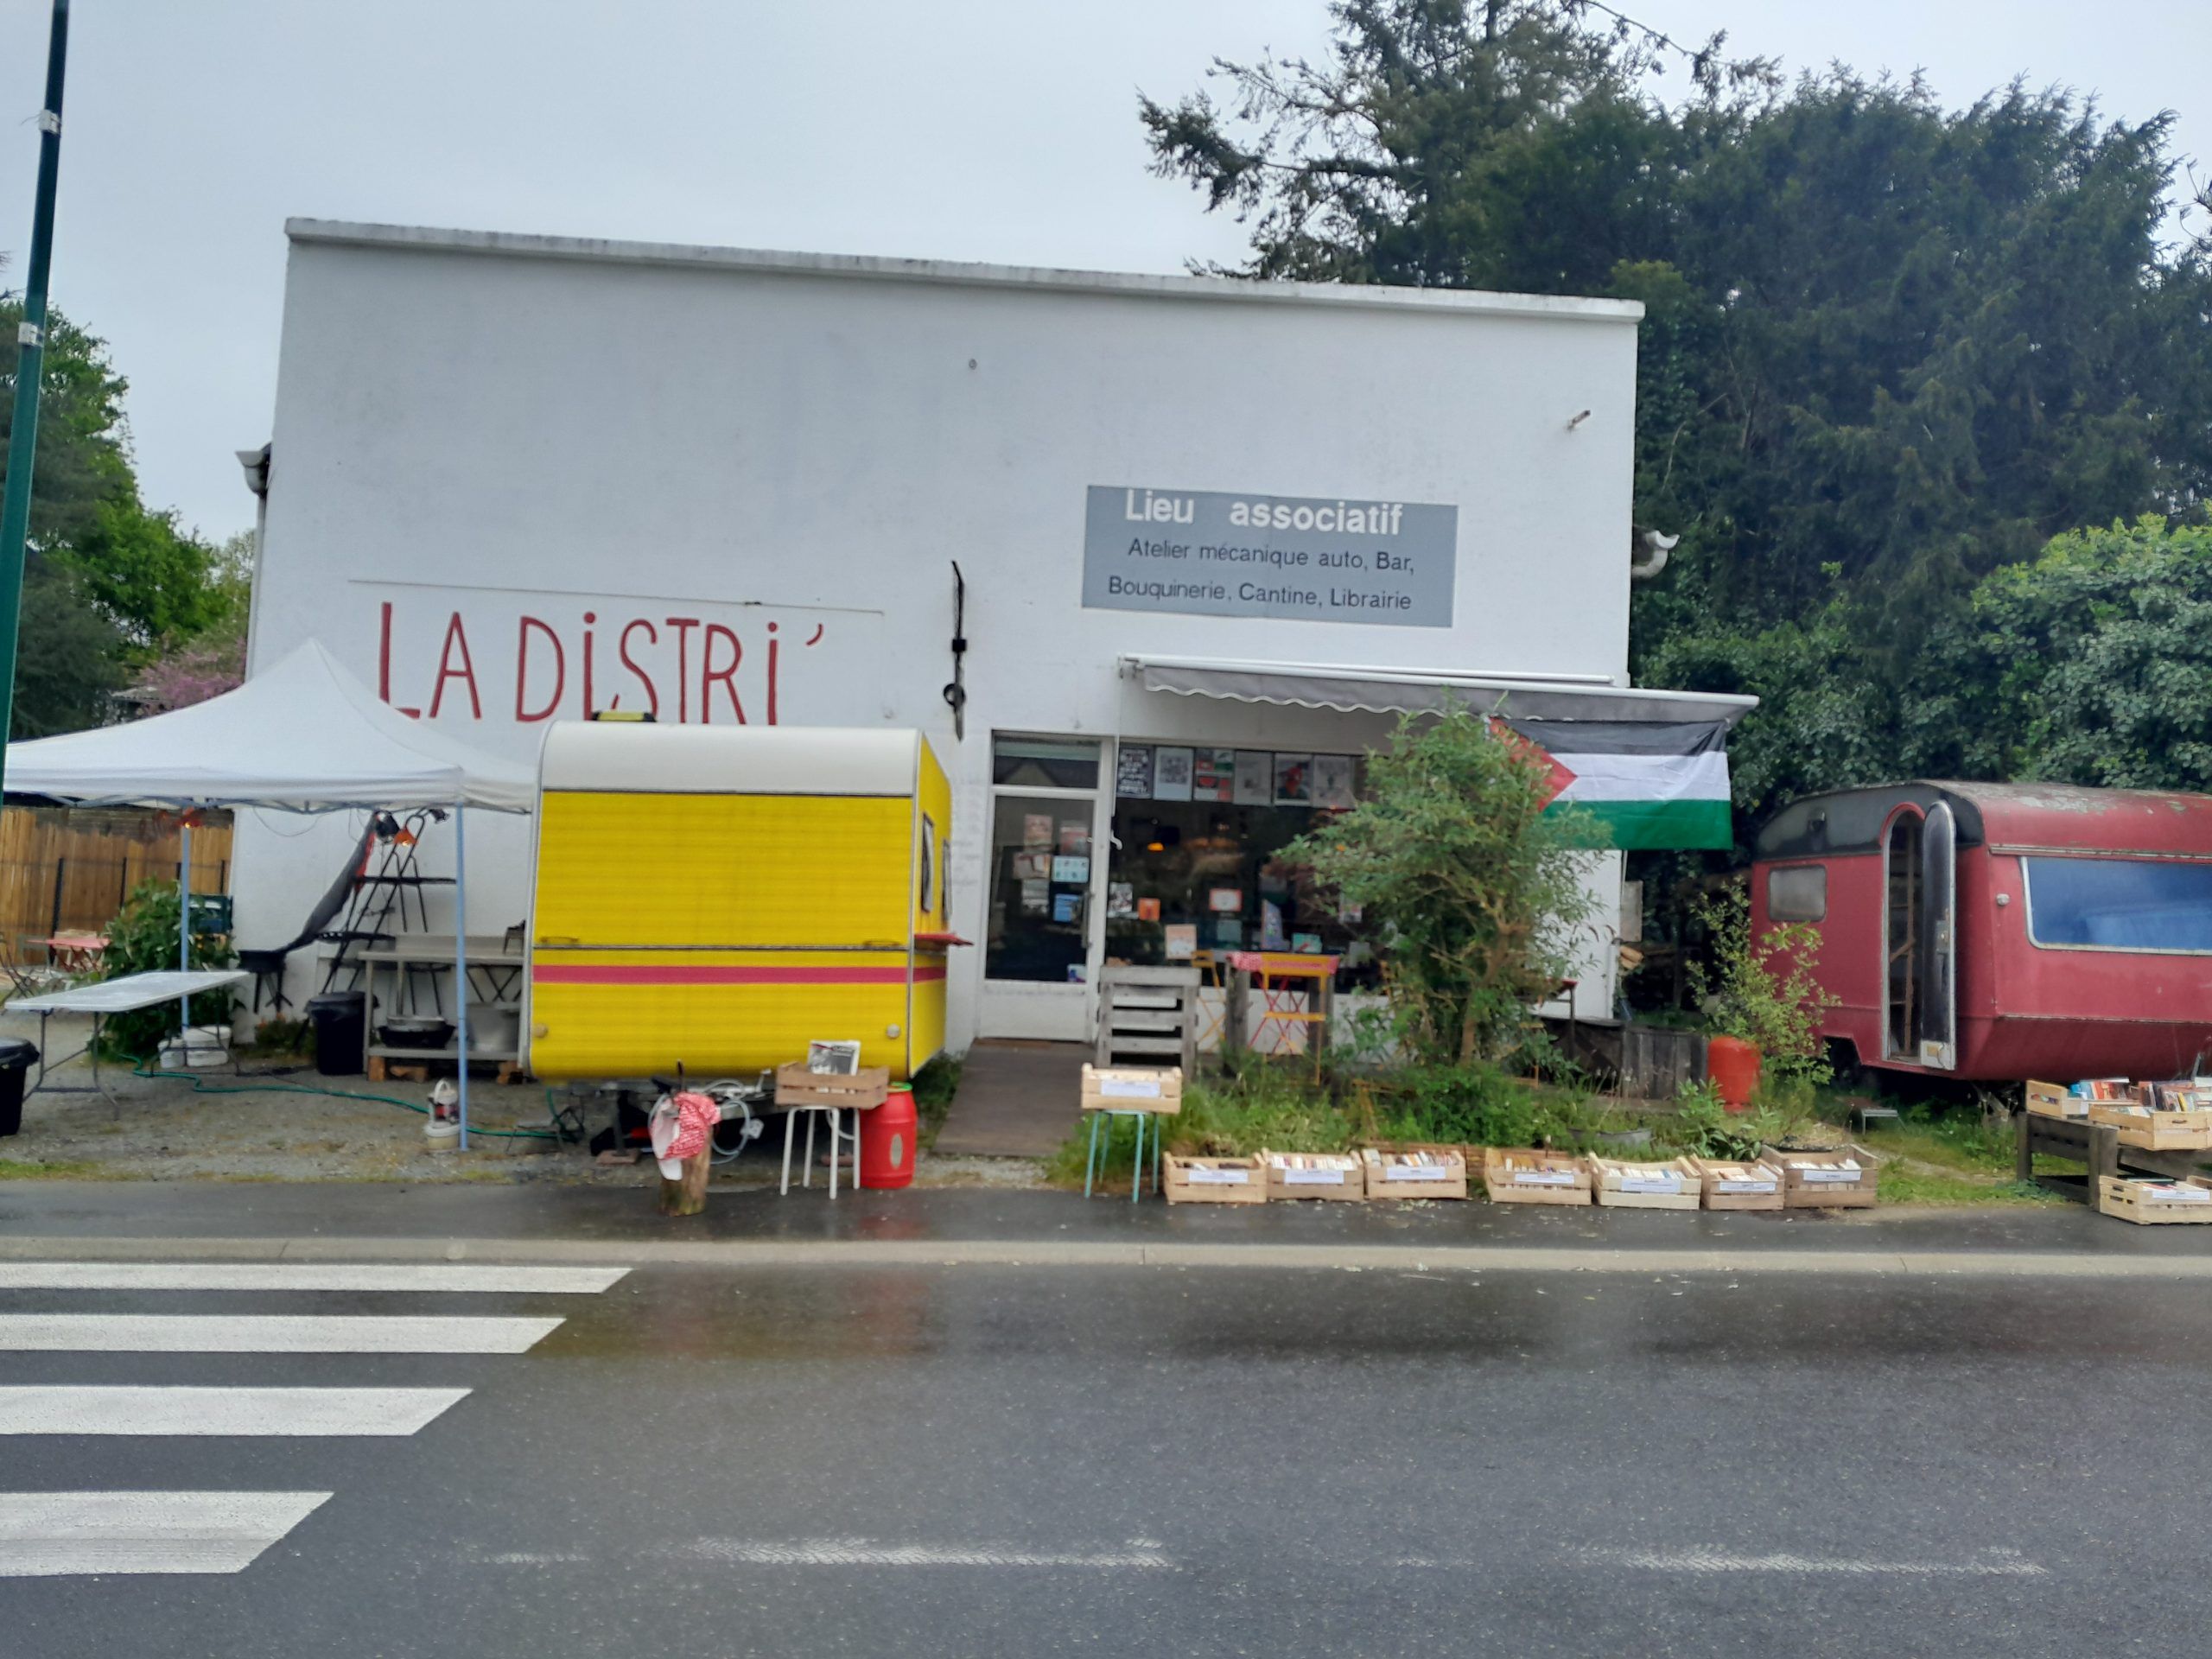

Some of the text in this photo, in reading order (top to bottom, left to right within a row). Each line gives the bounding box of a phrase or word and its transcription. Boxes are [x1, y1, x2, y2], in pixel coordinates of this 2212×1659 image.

[1125, 488, 1404, 536] Lieu associatif
[1128, 537, 1414, 575] Atelier mécanique auto, Bar,
[1109, 575, 1413, 610] Bouquinerie, Cantine, Librairie
[379, 602, 481, 721] LA
